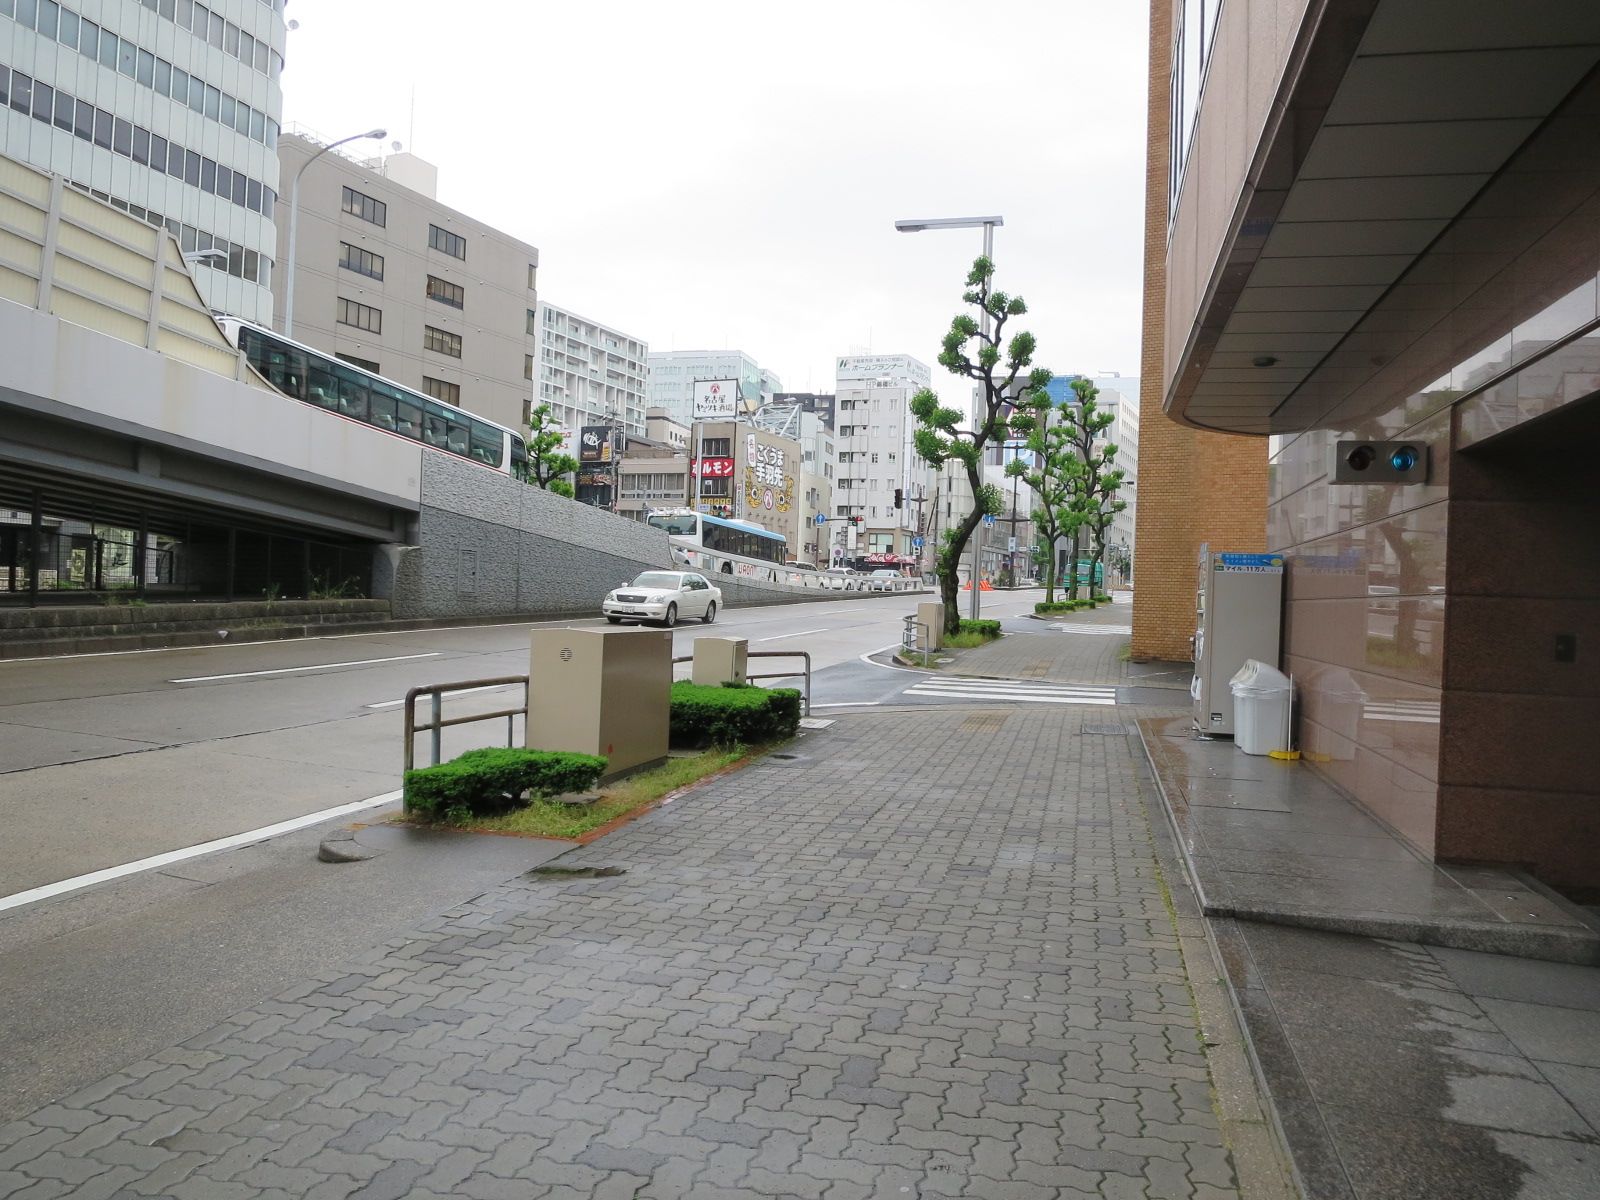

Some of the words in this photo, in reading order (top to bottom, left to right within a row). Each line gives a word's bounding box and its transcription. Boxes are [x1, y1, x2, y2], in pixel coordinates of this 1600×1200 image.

[757, 443, 785, 467] こくうま
[755, 462, 783, 488] 手羽先
